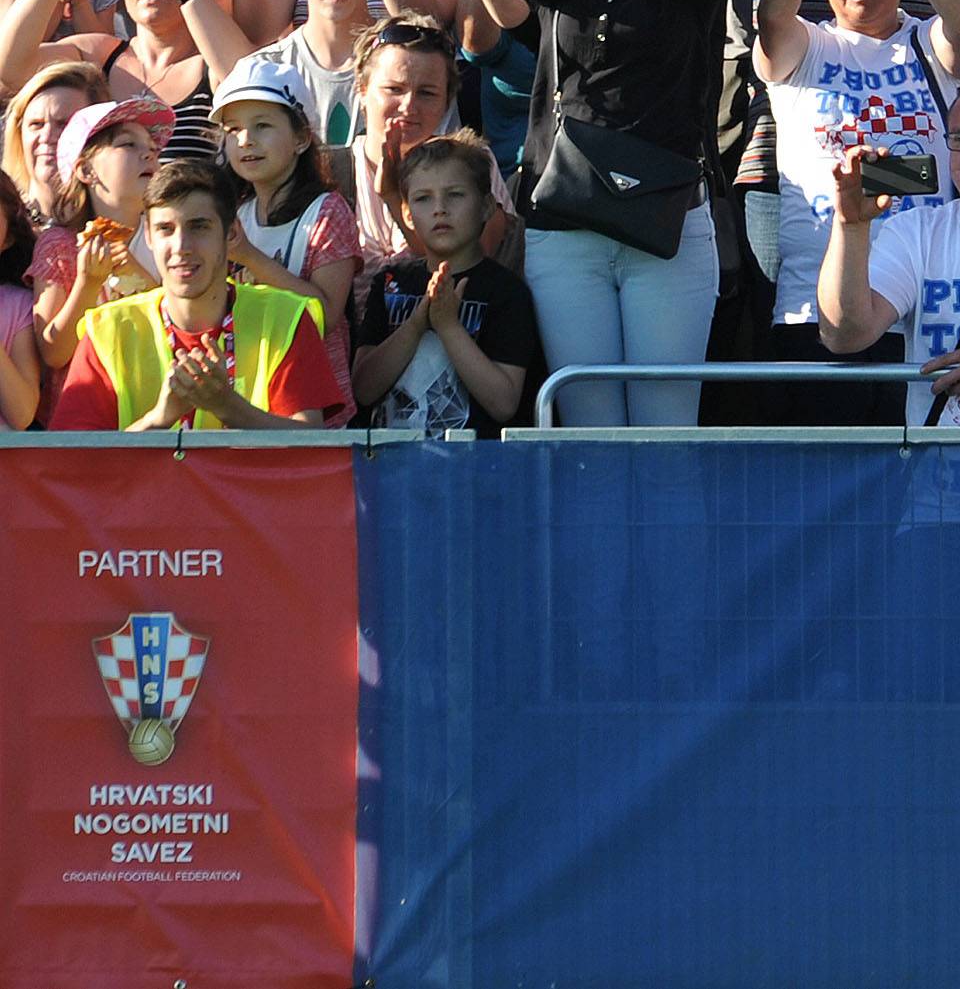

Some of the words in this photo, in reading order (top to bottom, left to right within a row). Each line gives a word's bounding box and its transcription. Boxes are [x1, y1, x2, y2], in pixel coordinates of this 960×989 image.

[892, 88, 936, 113] BE
[78, 549, 224, 578] PARTNER
[141, 626, 162, 705] HNS
[89, 784, 214, 807] HRVATSKI
[73, 812, 231, 835] NOGOMETNI
[110, 841, 194, 864] SAVEZ
[62, 871, 116, 883] CROATIAN
[116, 871, 173, 883] FOOTBALL
[174, 870, 241, 883] FEDERATION
